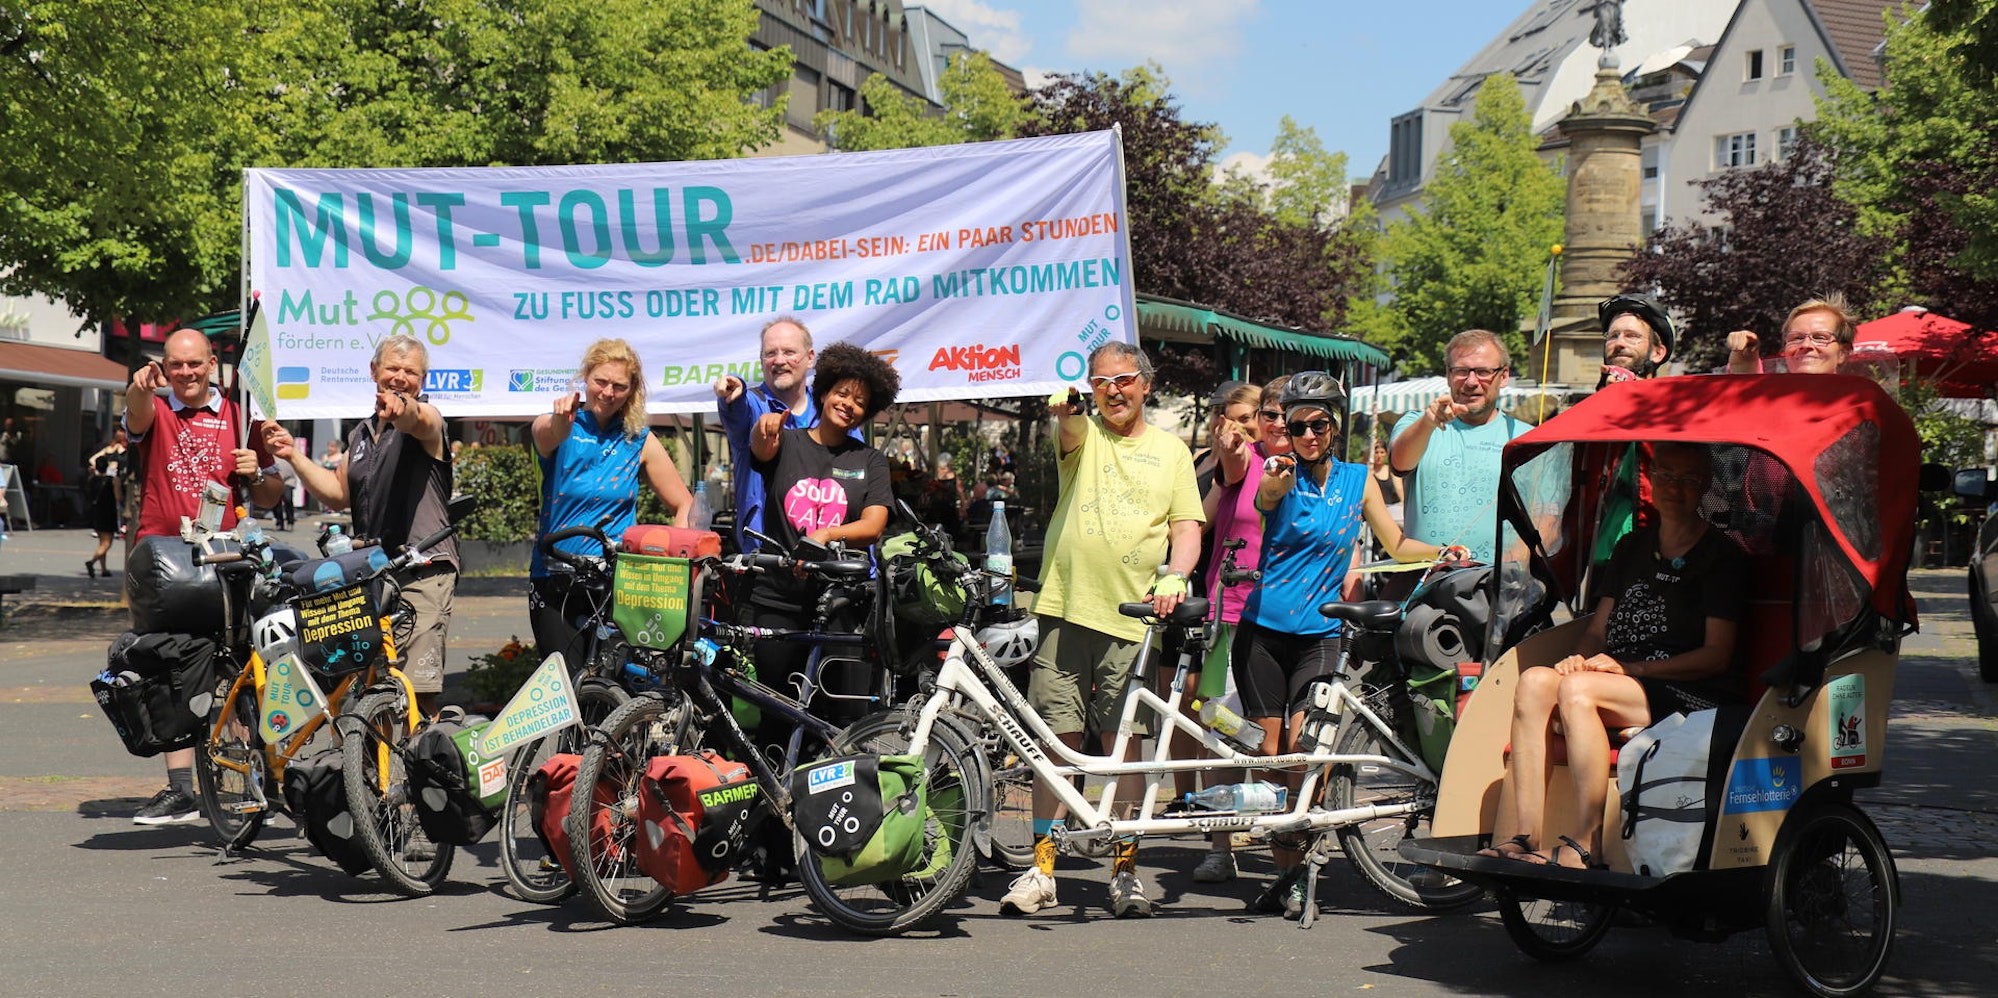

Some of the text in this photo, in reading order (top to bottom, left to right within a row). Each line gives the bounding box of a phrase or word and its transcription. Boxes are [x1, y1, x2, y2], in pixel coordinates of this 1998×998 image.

[274, 186, 742, 270] MUT-TOUR
[917, 231, 950, 252] EIN
[958, 225, 1012, 248] PAAR
[1021, 212, 1119, 243] STUNDEN
[513, 257, 1121, 320] ZU FUSS ODER MIT DEM RAD MITKOMMEN
[277, 288, 359, 326] Mut
[277, 331, 344, 350] fördern
[1077, 318, 1099, 342] MUT
[1086, 328, 1111, 351] TOUR
[320, 366, 359, 375] Deutsche
[426, 371, 460, 389] LVR
[967, 368, 1021, 383] MENSCH
[534, 384, 550, 392] des
[792, 479, 848, 505] SOUL
[332, 591, 348, 601] Mut
[652, 582, 677, 593] Thema
[300, 607, 327, 619] Wissen
[337, 595, 367, 609] Umgang
[616, 589, 685, 610] Depression
[307, 606, 361, 627] mit dem Thema
[302, 615, 374, 644] Depression
[269, 681, 280, 701] MUT
[281, 682, 293, 705] TOUR
[506, 694, 568, 728] DEPRESSION
[484, 738, 501, 752] IST
[502, 707, 572, 745] BEHANDELBAR
[988, 704, 1044, 762] SCHAUFF
[811, 767, 837, 785] LVR
[700, 783, 758, 807] BARMER
[1729, 788, 1792, 805] Fernsehlotterie
[827, 802, 840, 820] MUT
[833, 806, 848, 826] TOUR
[727, 819, 739, 835] MUT
[1187, 817, 1259, 828] SCHAUFF
